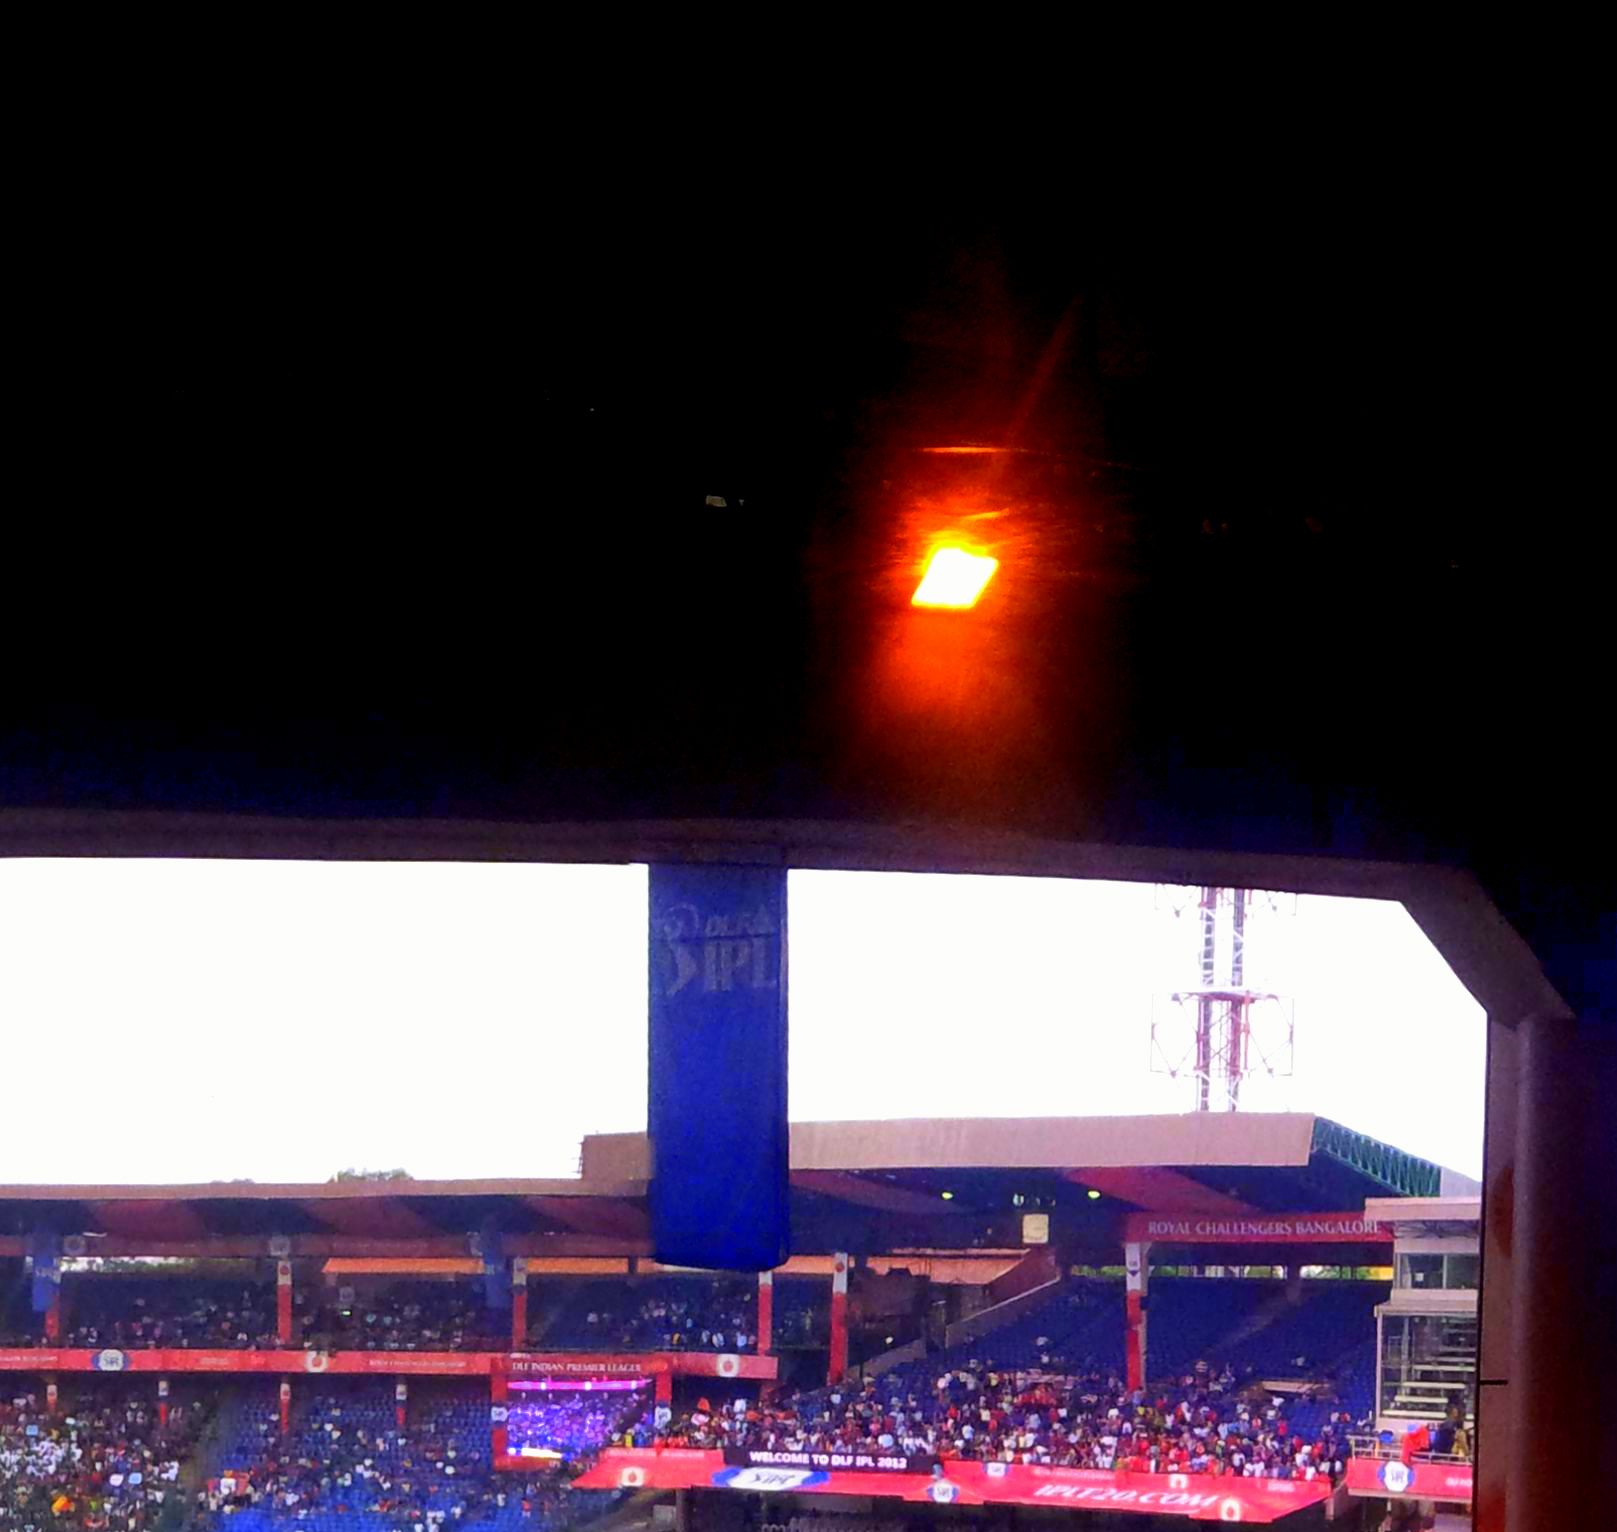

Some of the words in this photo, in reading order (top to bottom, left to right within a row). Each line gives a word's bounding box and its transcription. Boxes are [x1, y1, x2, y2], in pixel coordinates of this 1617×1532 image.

[1148, 1221, 1191, 1235] ROYAL
[1195, 1221, 1292, 1236] CHALLENGERS
[749, 1450, 809, 1466] WELCOME
[811, 1453, 828, 1467] TO
[830, 1454, 853, 1468] DLF
[855, 1455, 875, 1468] IPL
